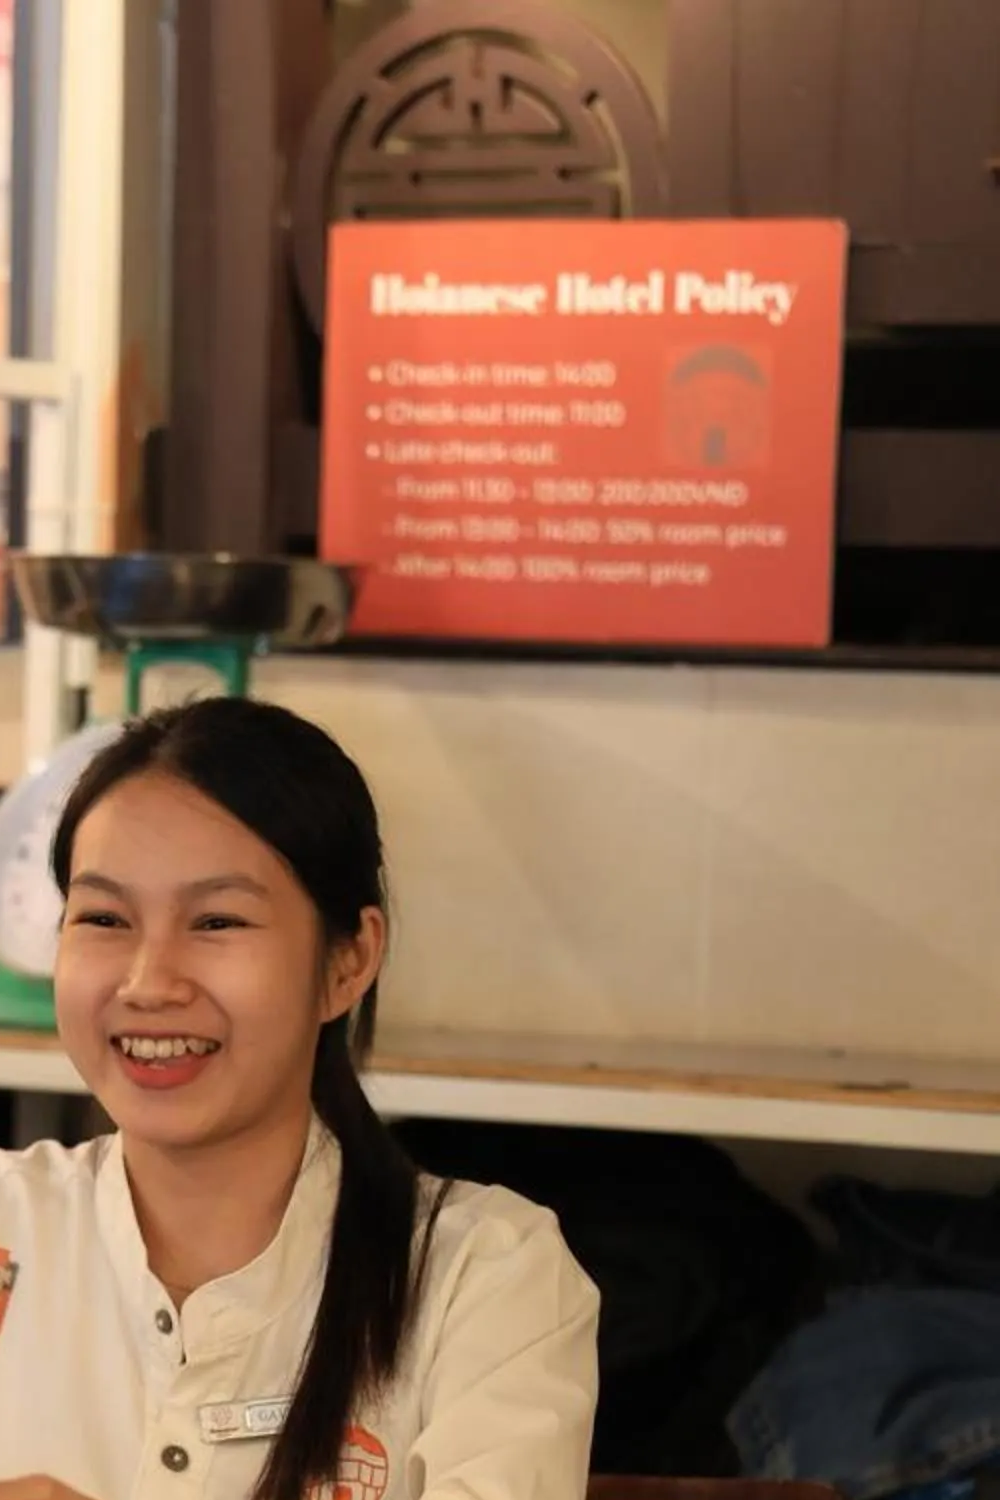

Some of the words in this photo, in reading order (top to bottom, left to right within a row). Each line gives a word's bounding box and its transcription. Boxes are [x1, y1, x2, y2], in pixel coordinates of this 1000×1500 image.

[556, 269, 665, 316] Hotel
[674, 268, 797, 326] Policy
[386, 359, 489, 387] Check-in
[725, 523, 788, 553] price
[649, 560, 712, 588] price
